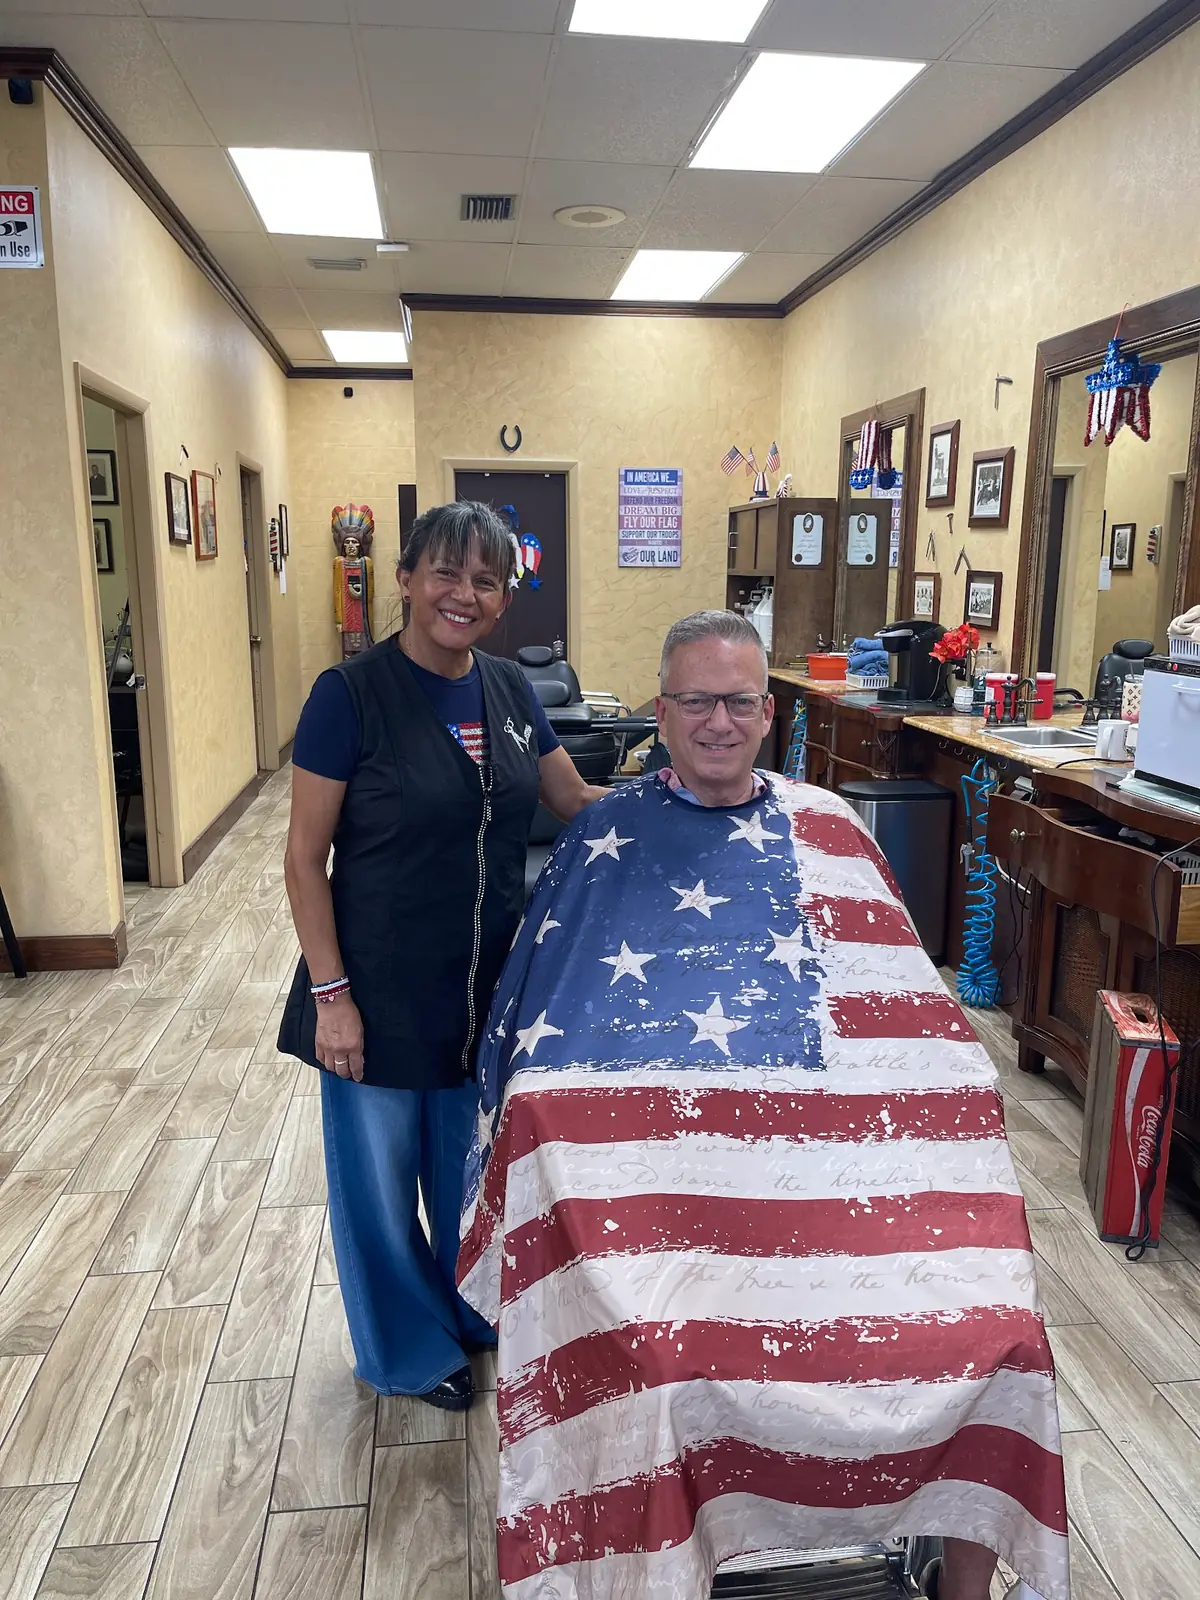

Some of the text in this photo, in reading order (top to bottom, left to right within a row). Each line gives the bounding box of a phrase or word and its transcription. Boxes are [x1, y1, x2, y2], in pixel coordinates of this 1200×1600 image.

[0, 195, 29, 212] NG
[10, 241, 31, 257] Use
[626, 471, 634, 483] IN
[624, 506, 678, 515] DREAM BIG
[624, 516, 678, 529] FLY OUR FLAG
[621, 530, 679, 539] SUPPORT OUR TROOPS
[640, 550, 678, 562] OUR LAND
[845, 958, 912, 982] home
[671, 1172, 738, 1189] save
[772, 1173, 808, 1192] the
[850, 1271, 891, 1290] the
[904, 1259, 995, 1287] home
